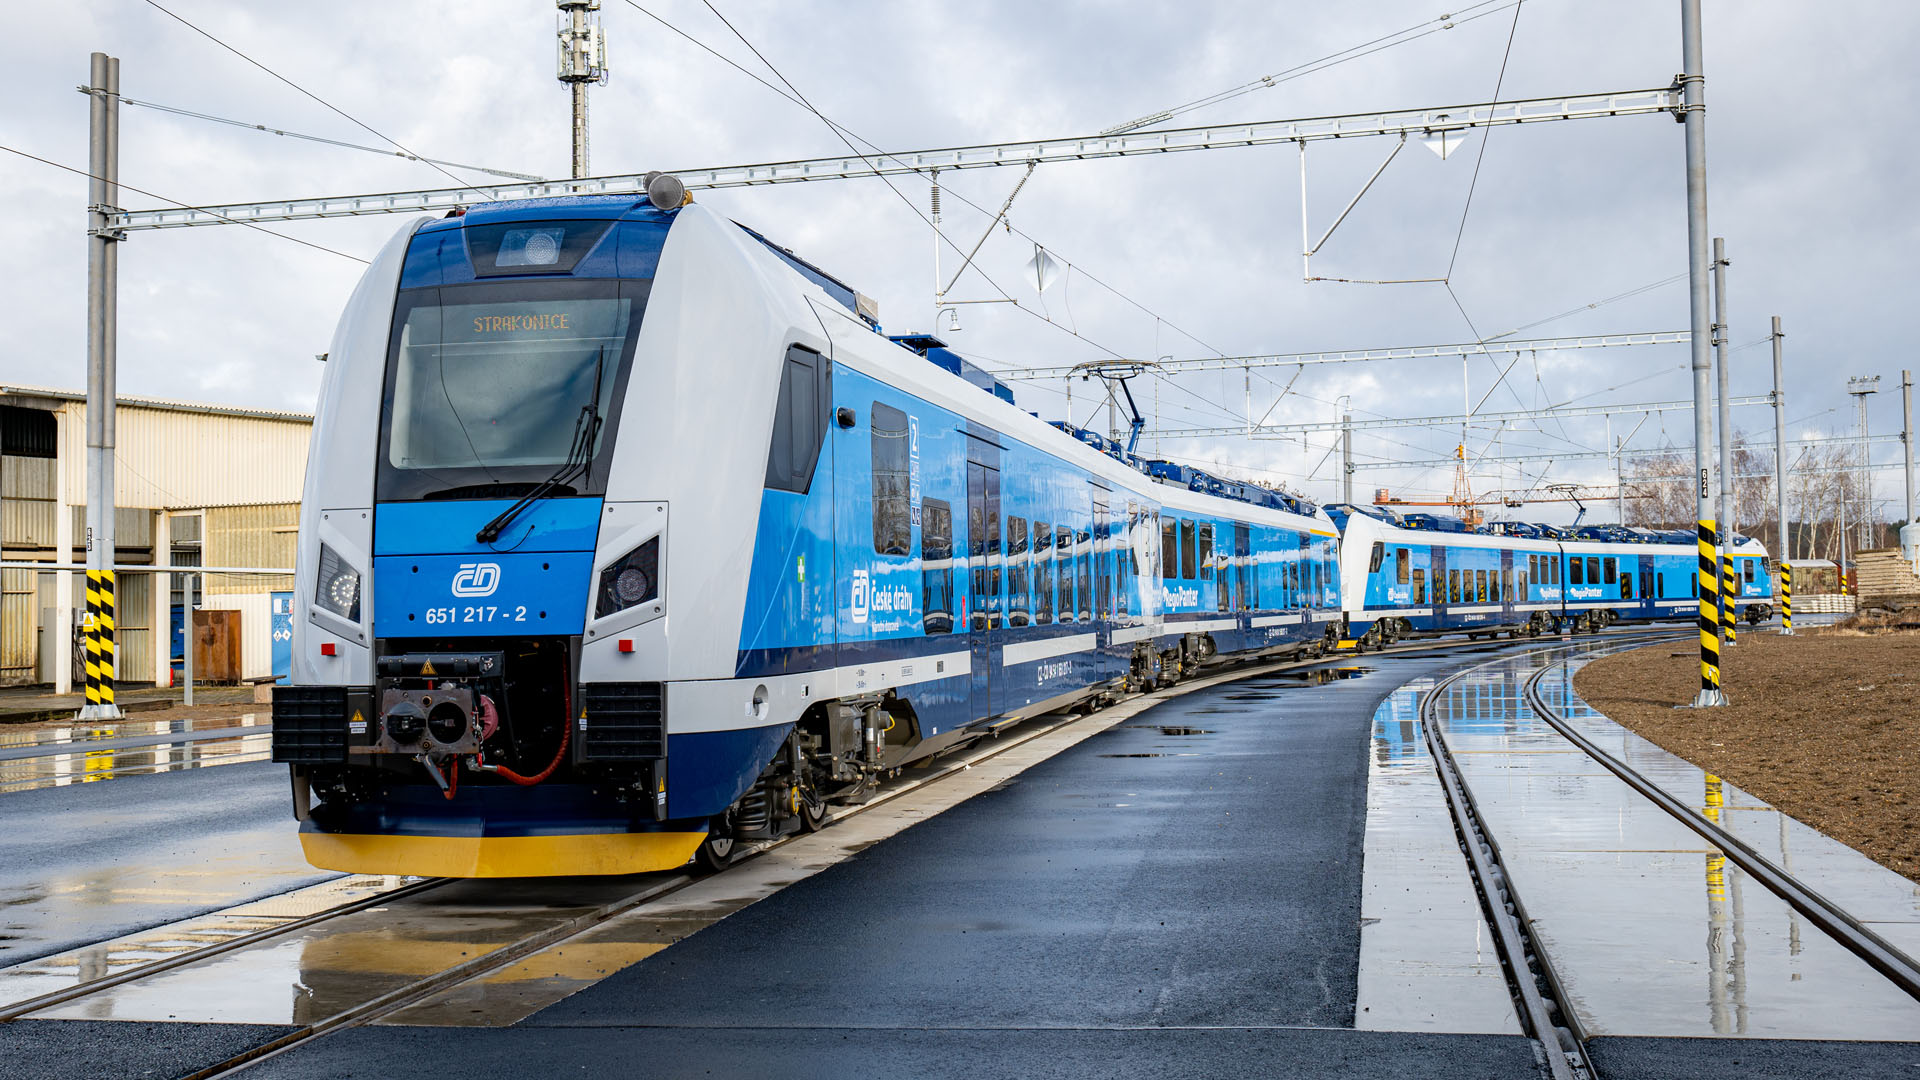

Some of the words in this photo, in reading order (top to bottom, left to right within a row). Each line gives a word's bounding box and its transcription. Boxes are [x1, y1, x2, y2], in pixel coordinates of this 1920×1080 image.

[473, 312, 569, 333] STRAKONICE
[912, 424, 917, 451] 2
[871, 580, 892, 611] České
[893, 584, 912, 616] dráhy
[1165, 586, 1198, 611] RegioPanter
[425, 607, 456, 624] 651
[463, 606, 498, 623] 217
[514, 605, 527, 622] 2
